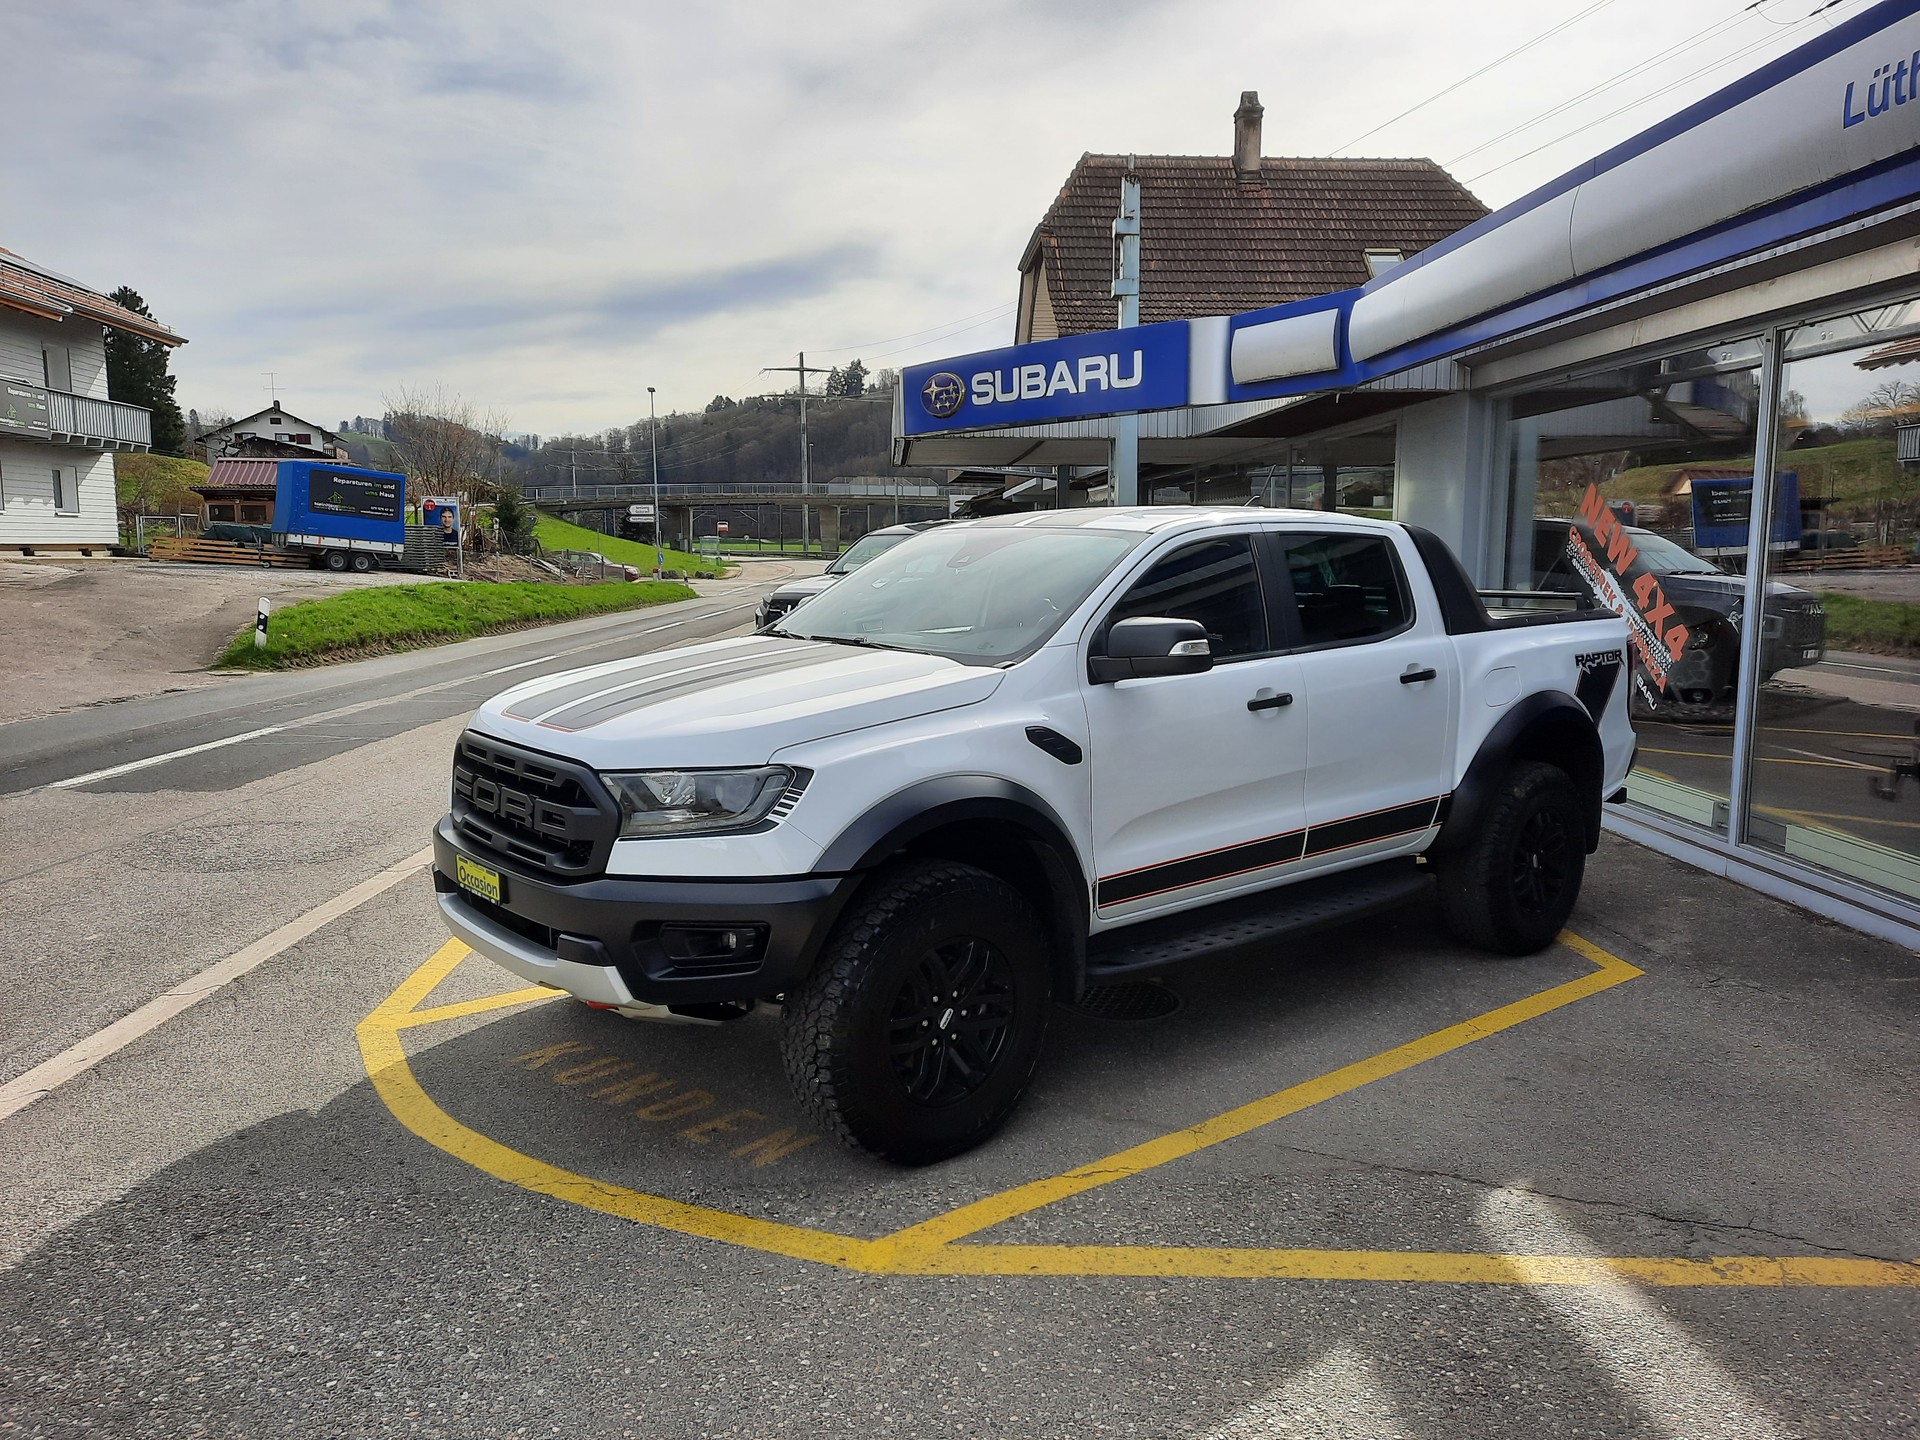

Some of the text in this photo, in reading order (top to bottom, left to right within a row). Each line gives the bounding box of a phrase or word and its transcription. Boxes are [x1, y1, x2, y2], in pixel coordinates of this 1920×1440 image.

[971, 350, 1143, 406] SUBARU
[333, 476, 373, 488] Reparaturen
[1569, 525, 1617, 608] CROSSTREK
[1579, 482, 1690, 663] NEW 4X4
[1574, 649, 1625, 672] RAPTOR
[454, 765, 577, 840] FORD
[459, 865, 498, 898] Occasion
[511, 1040, 820, 1168] KUNDEN
